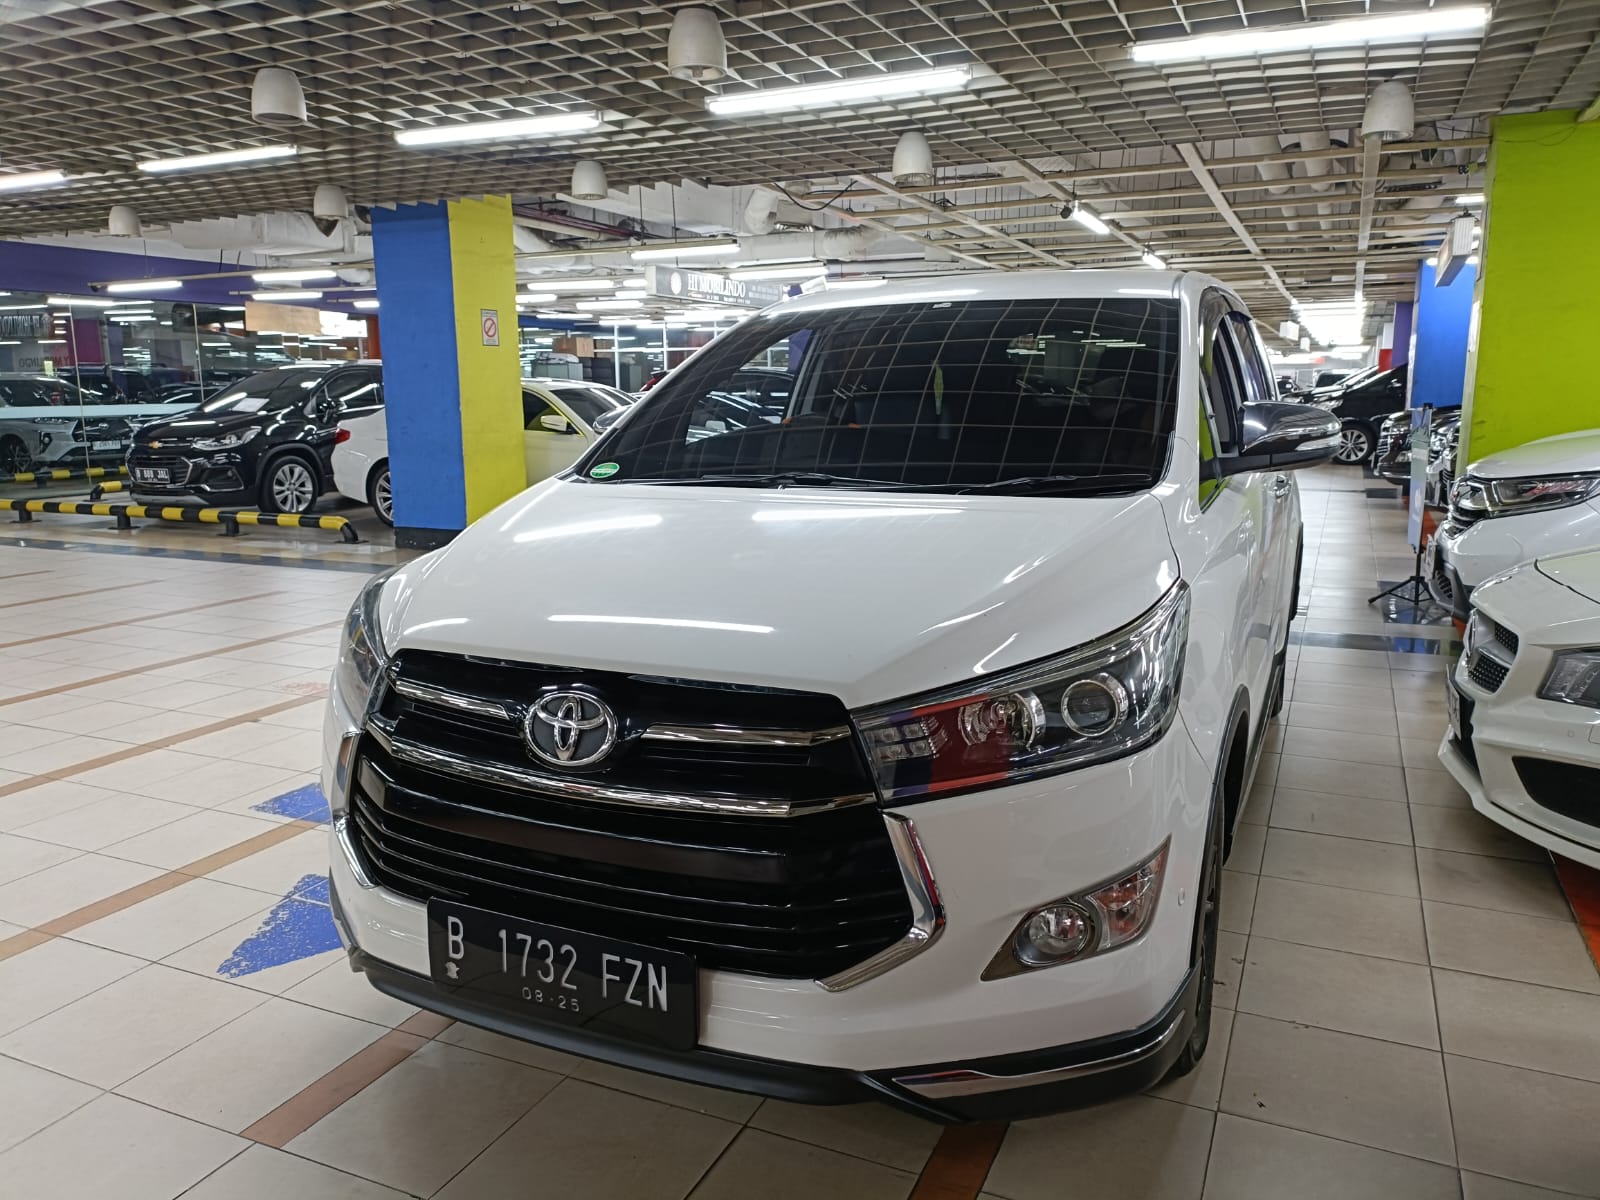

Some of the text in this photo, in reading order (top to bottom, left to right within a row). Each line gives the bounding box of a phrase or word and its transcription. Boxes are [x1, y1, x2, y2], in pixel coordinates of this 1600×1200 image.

[447, 915, 668, 1012] B 1732 FZN
